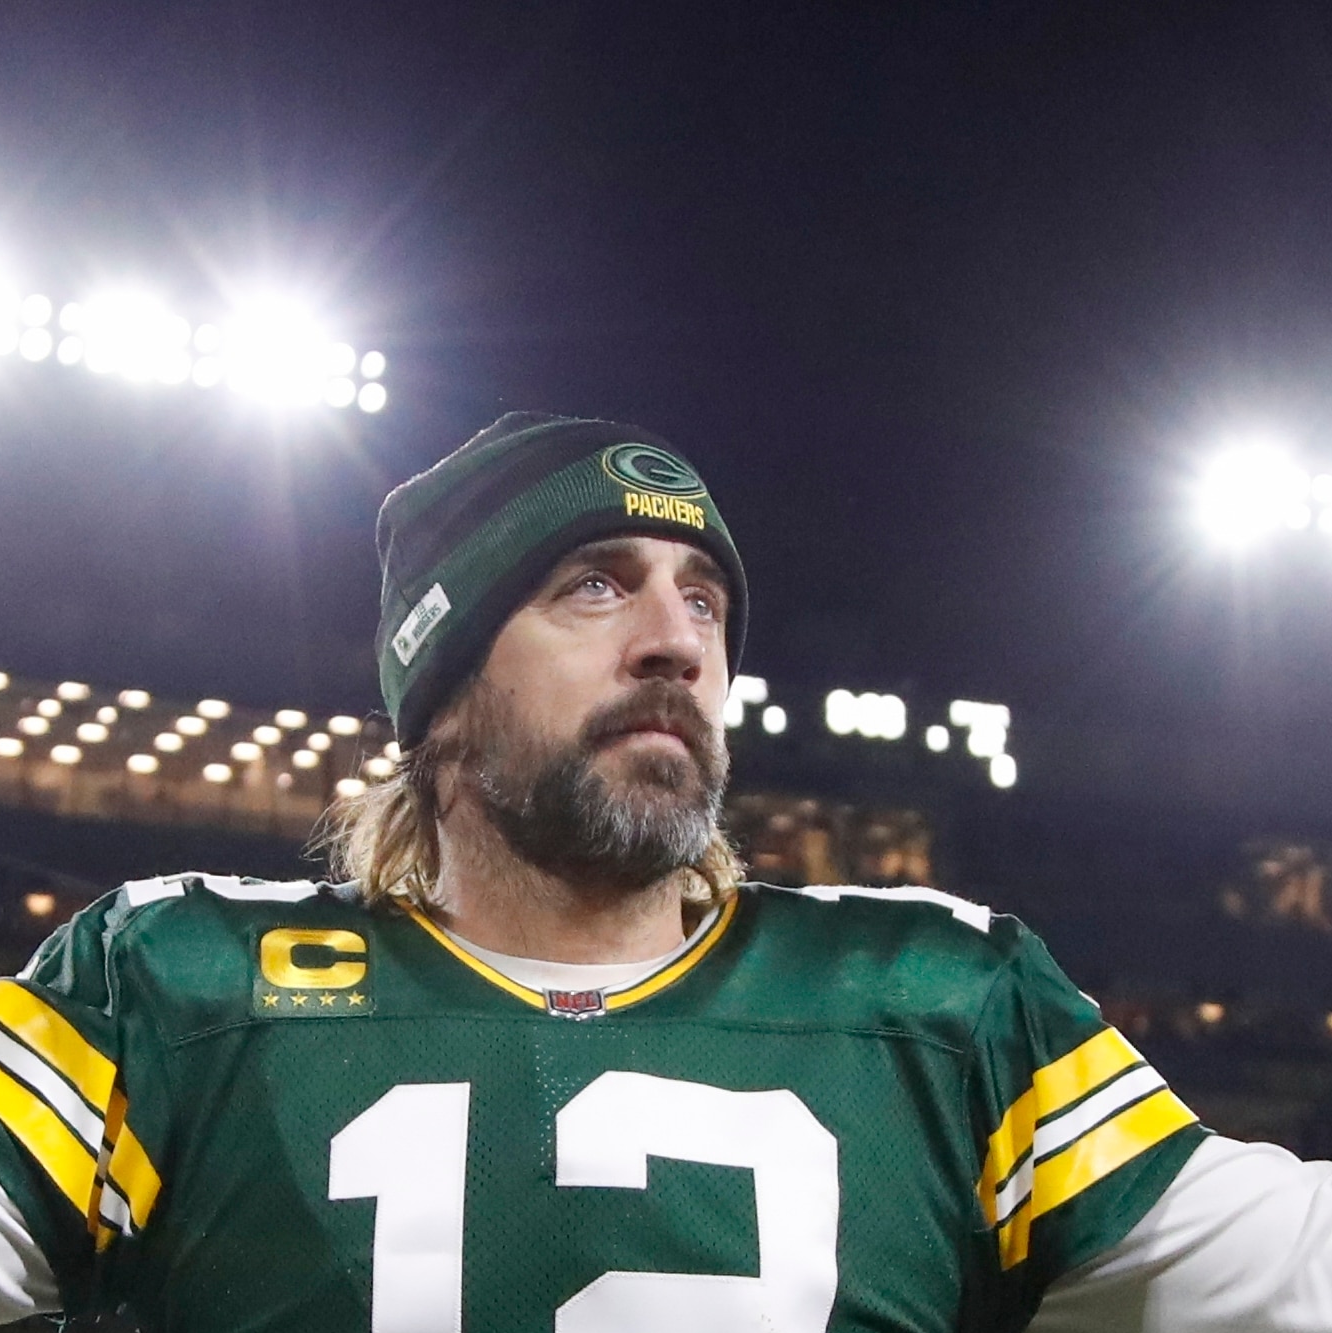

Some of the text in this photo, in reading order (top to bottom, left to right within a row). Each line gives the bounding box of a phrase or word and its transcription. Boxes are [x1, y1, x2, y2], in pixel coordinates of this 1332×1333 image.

[625, 492, 705, 530] PACKERS
[260, 928, 367, 989] C
[553, 990, 598, 1010] NFL
